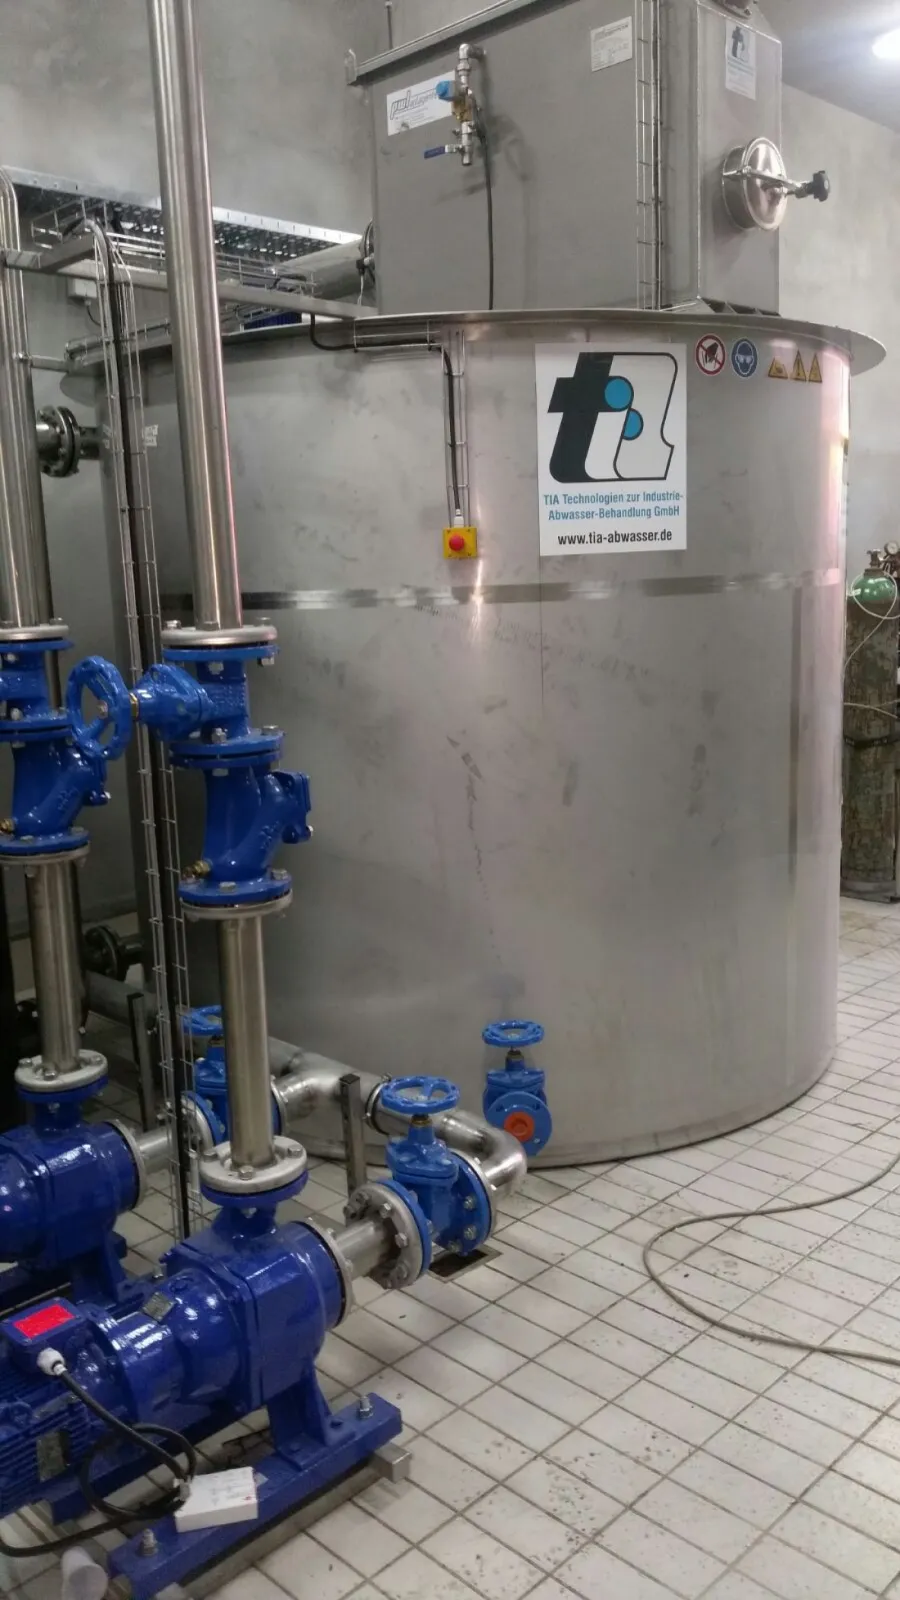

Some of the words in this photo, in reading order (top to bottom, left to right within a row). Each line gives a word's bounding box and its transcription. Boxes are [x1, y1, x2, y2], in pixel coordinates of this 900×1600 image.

[543, 494, 560, 506] TIA
[562, 492, 625, 505] Technologien
[626, 493, 640, 503] zur
[643, 491, 684, 502] Industrie-
[548, 507, 652, 521] Abwasser-Behandlung
[654, 505, 680, 517] GmbH
[557, 528, 673, 545] www.tia-abwasser.de
